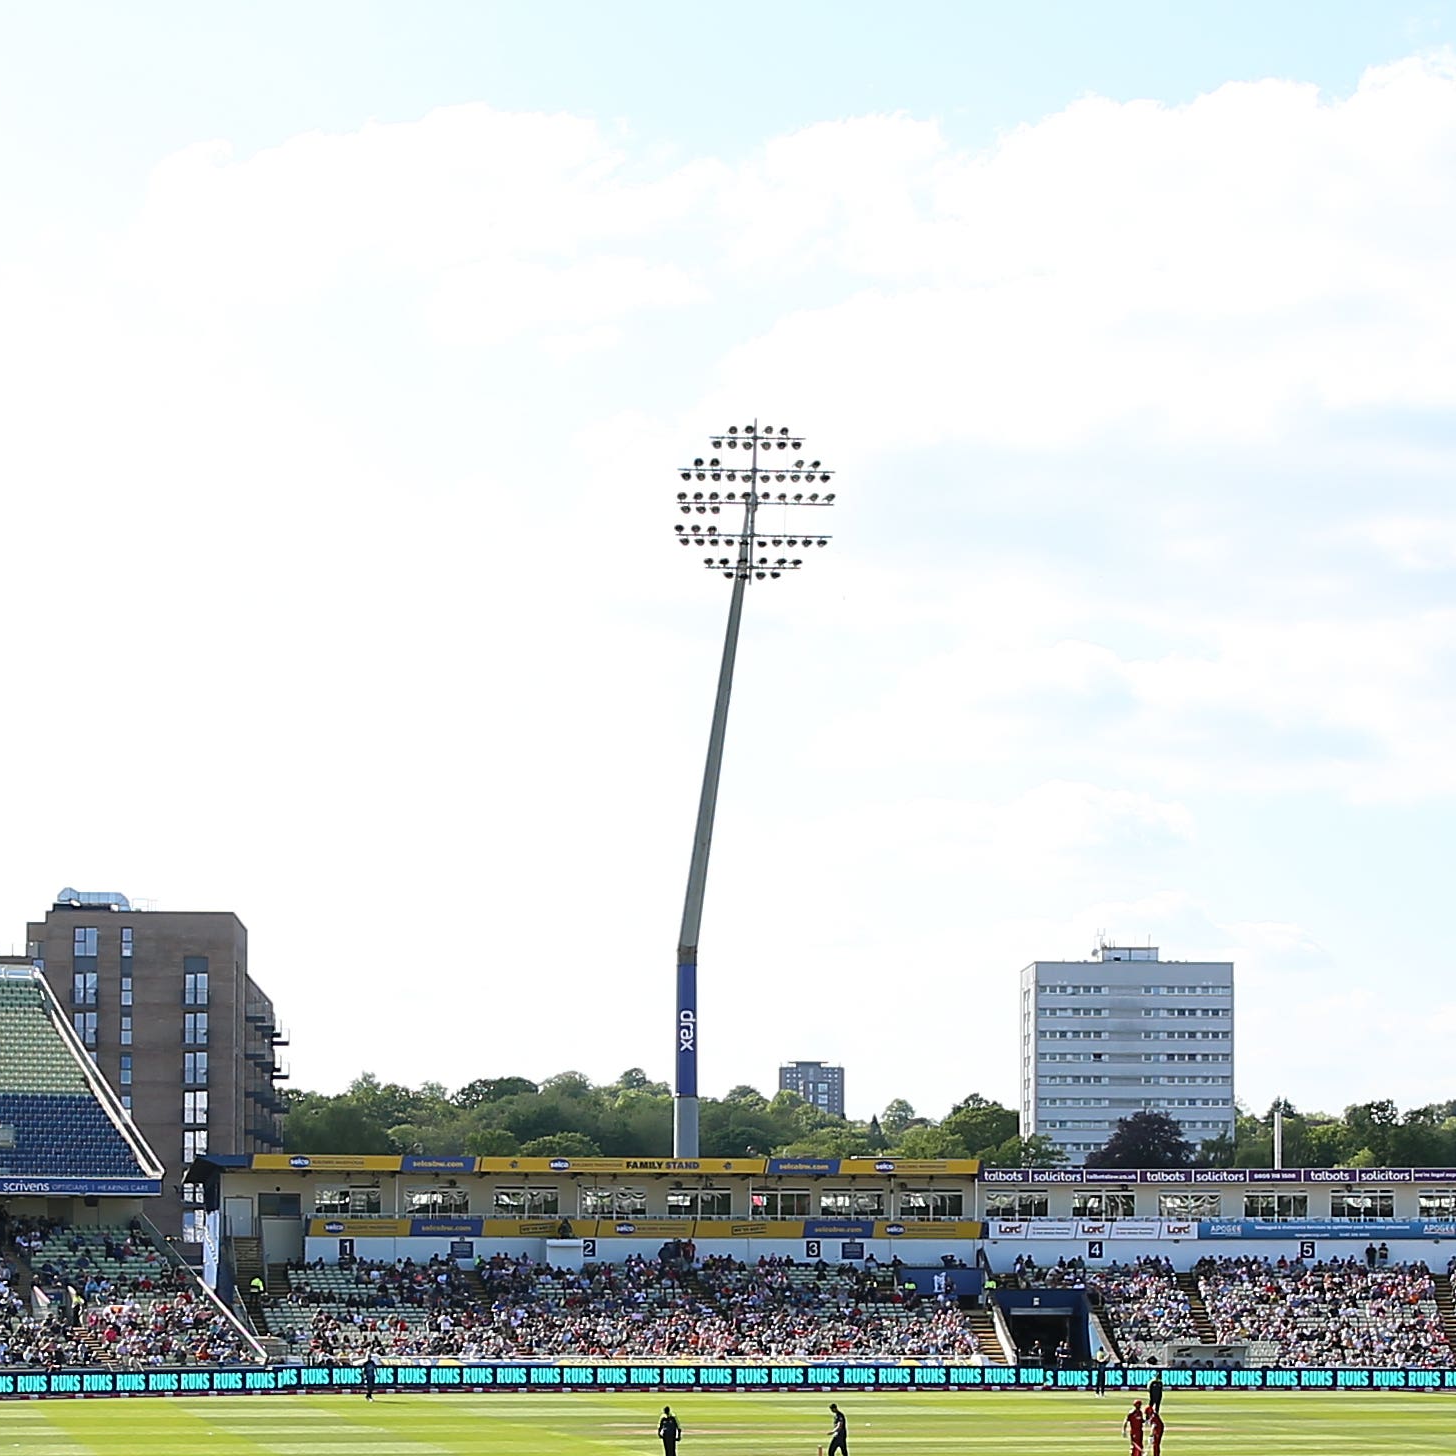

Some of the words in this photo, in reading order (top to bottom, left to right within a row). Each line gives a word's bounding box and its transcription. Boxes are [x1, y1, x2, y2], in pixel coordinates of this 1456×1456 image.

[680, 1010, 696, 1052] drax
[626, 1161, 664, 1171] FAMILY
[666, 1161, 700, 1171] STAND
[984, 1171, 1024, 1182] talbots
[1033, 1170, 1082, 1182] solicitors
[1147, 1171, 1185, 1182] talbots
[1196, 1171, 1245, 1182] solicitors
[1310, 1170, 1350, 1181] talbots
[1361, 1170, 1410, 1181] solicitors
[2, 1180, 50, 1193] scrivens
[344, 1242, 351, 1255] 1
[583, 1242, 593, 1256] 2
[808, 1242, 818, 1256] 3
[1090, 1243, 1101, 1257] 4
[1303, 1243, 1313, 1257] 5
[665, 1368, 696, 1384] RUNS
[808, 1368, 840, 1384] RUNS
[1232, 1370, 1263, 1386] RUNS
